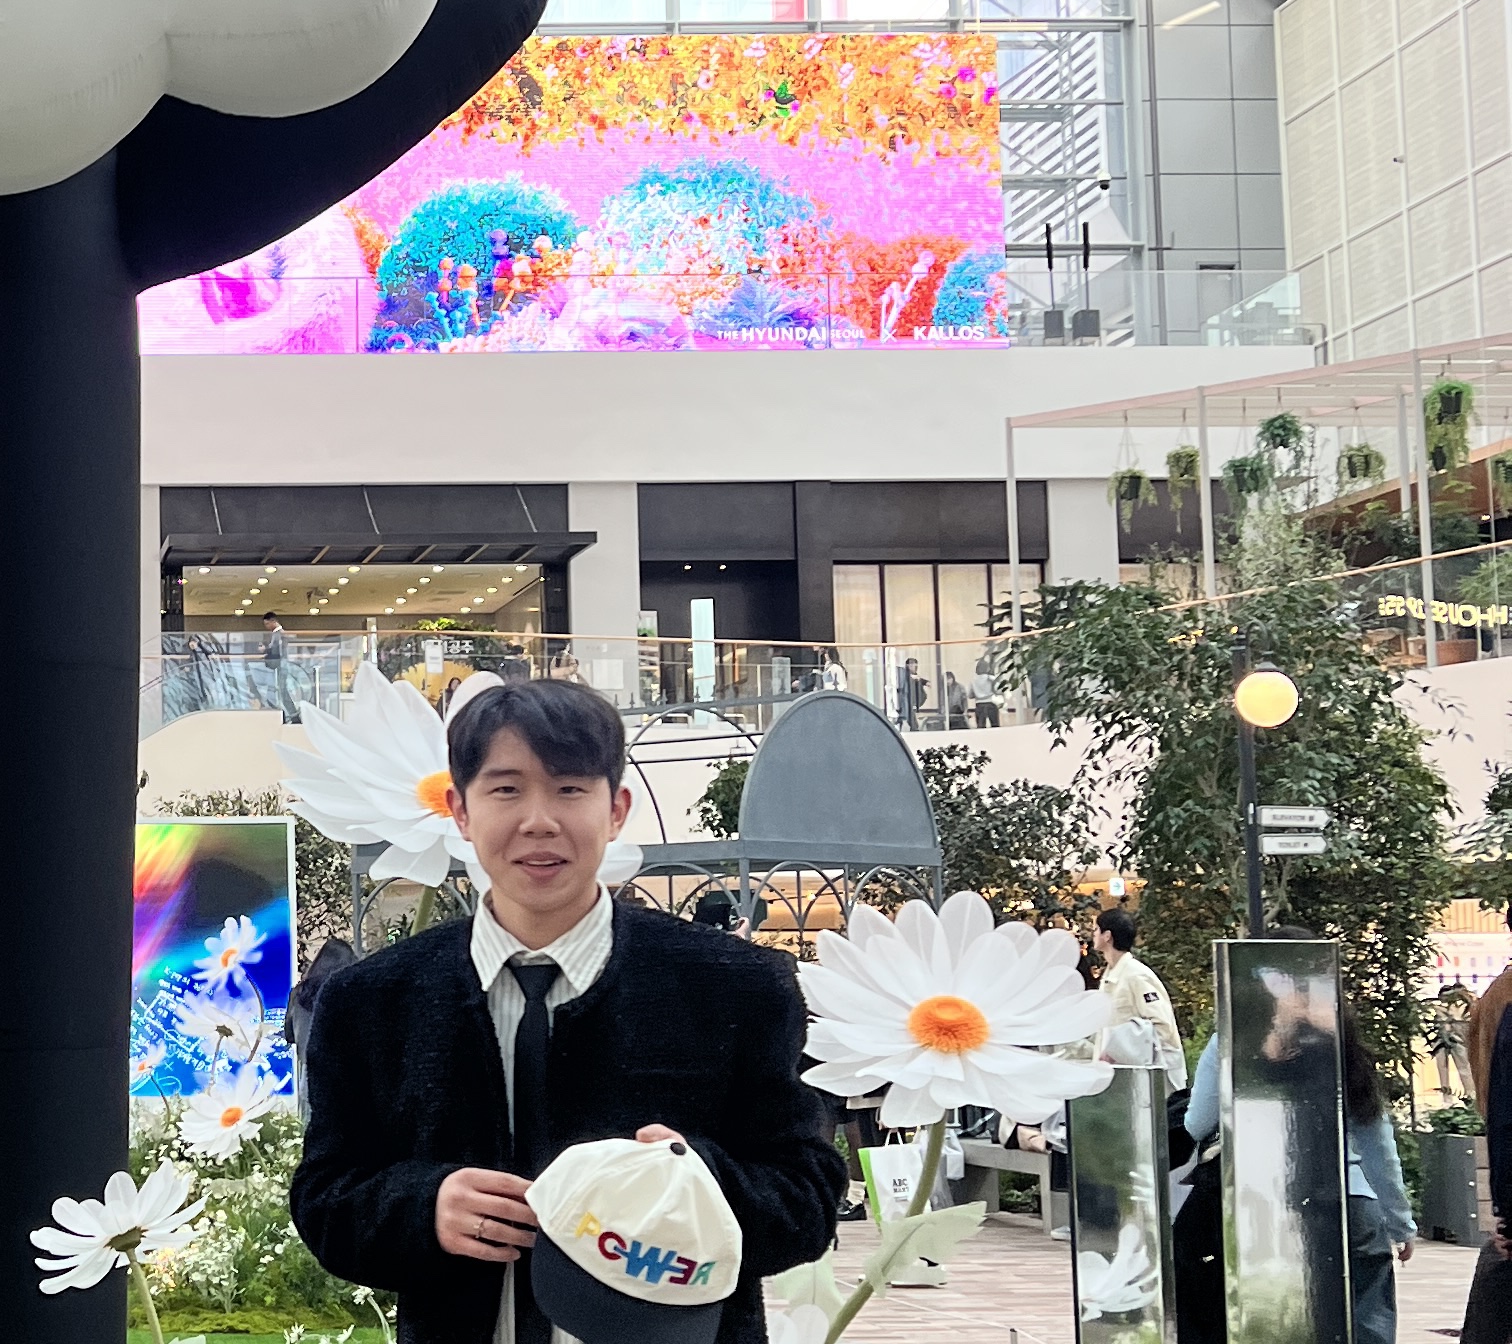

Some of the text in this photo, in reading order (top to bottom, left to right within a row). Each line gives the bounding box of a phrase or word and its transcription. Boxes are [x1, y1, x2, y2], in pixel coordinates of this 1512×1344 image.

[717, 330, 739, 340] THE
[741, 327, 826, 342] HYUNDAI
[830, 329, 865, 339] SEOUL
[913, 326, 985, 341] KALLOS
[575, 1212, 716, 1286] POWER
